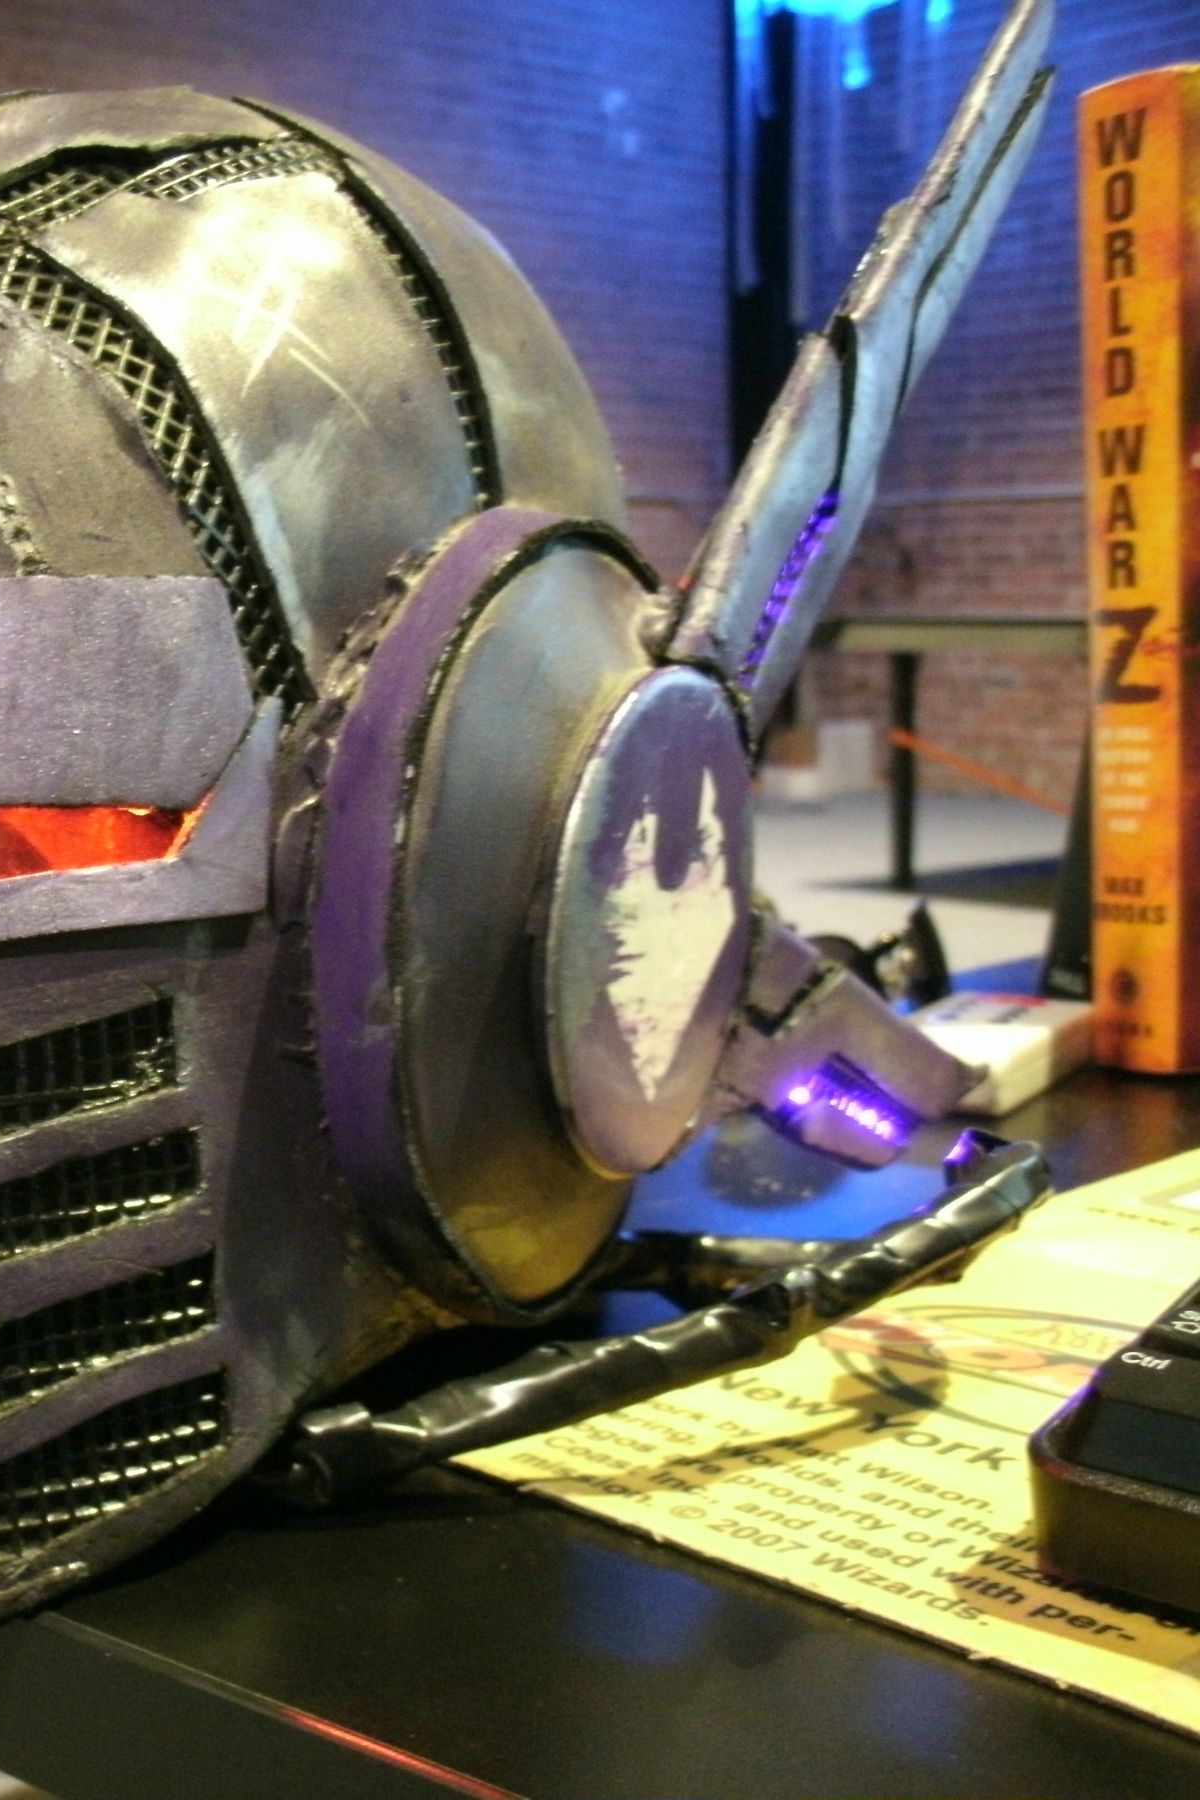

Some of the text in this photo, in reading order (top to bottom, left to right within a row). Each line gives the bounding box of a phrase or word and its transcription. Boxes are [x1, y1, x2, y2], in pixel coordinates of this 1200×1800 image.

[1097, 106, 1146, 398] WORLD
[1097, 424, 1145, 590] WAR
[1097, 606, 1161, 705] Z
[1120, 1351, 1171, 1370] Ctrl
[716, 1442, 844, 1493] Worlds,
[860, 1491, 947, 1519] and
[861, 1410, 1020, 1471] York
[721, 1473, 898, 1532] property
[903, 1530, 958, 1549] of
[856, 1462, 994, 1514] Wilson.
[705, 1518, 810, 1554] 2007
[810, 1551, 990, 1627] Wizards.
[733, 1500, 817, 1531] and
[818, 1529, 928, 1569] used
[930, 1566, 1025, 1605] with
[1026, 1603, 1138, 1642] per-
